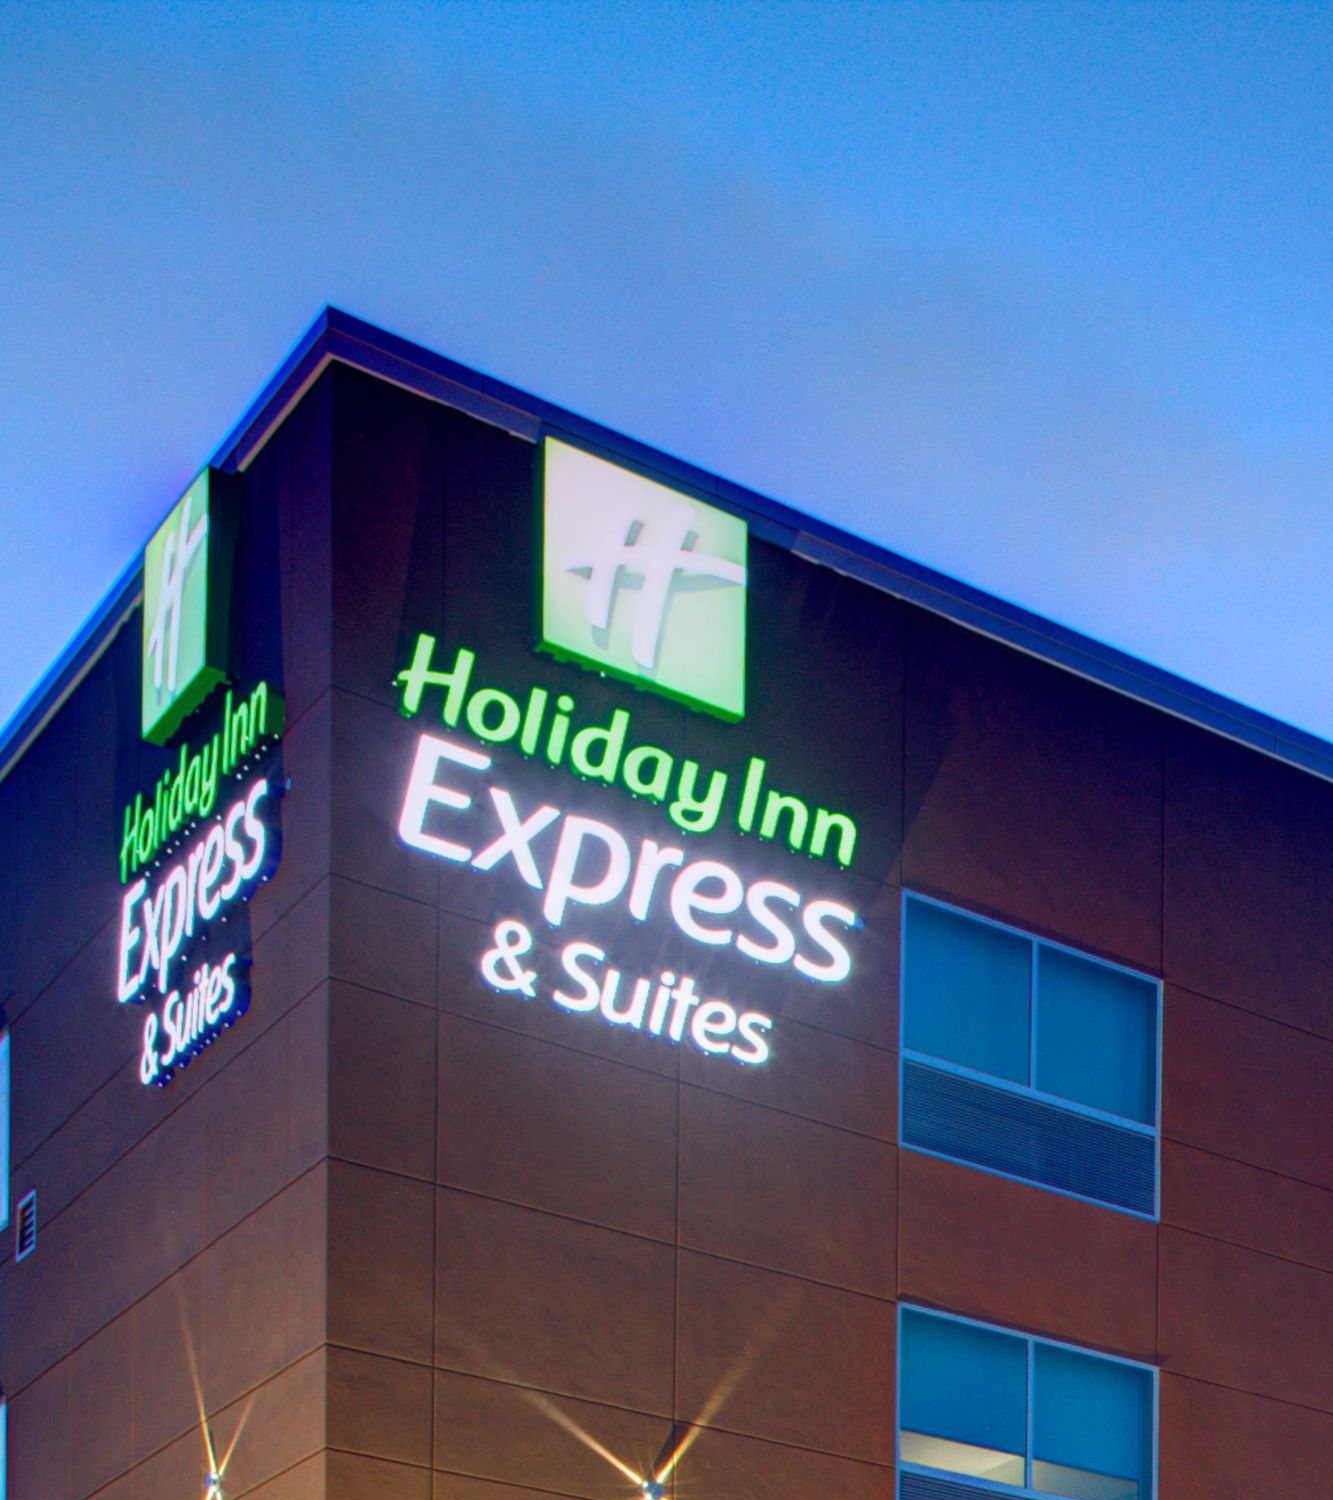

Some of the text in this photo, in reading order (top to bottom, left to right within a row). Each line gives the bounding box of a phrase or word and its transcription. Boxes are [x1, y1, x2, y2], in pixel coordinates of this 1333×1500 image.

[120, 681, 268, 883] Holiday Inn
[397, 633, 857, 866] Holiday Inn
[118, 778, 268, 1003] Express
[398, 733, 857, 982] Express
[139, 952, 236, 1085] & Suites
[480, 919, 772, 1064] & Suites
